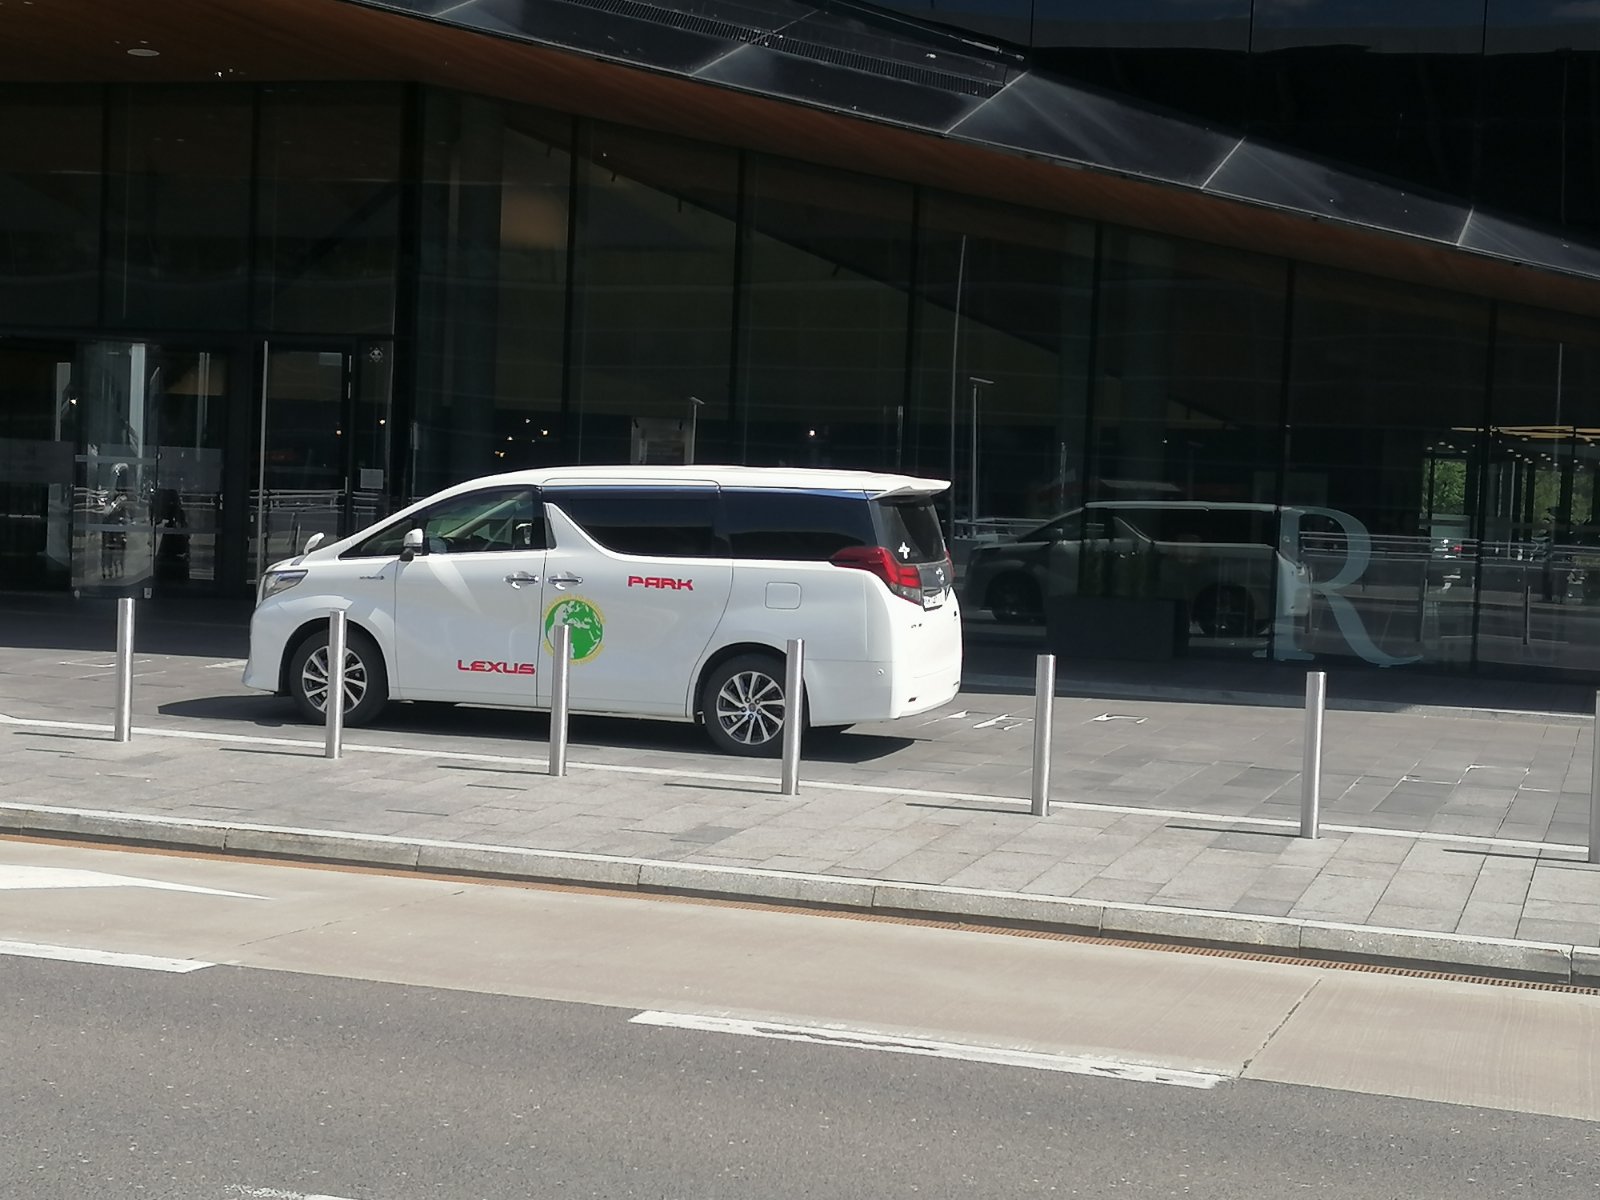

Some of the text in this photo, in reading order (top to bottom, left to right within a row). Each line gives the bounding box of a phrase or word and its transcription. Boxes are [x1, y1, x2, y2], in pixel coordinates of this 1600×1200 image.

[627, 575, 694, 591] PARK
[1252, 506, 1423, 667] R
[457, 659, 536, 675] LEXUS
